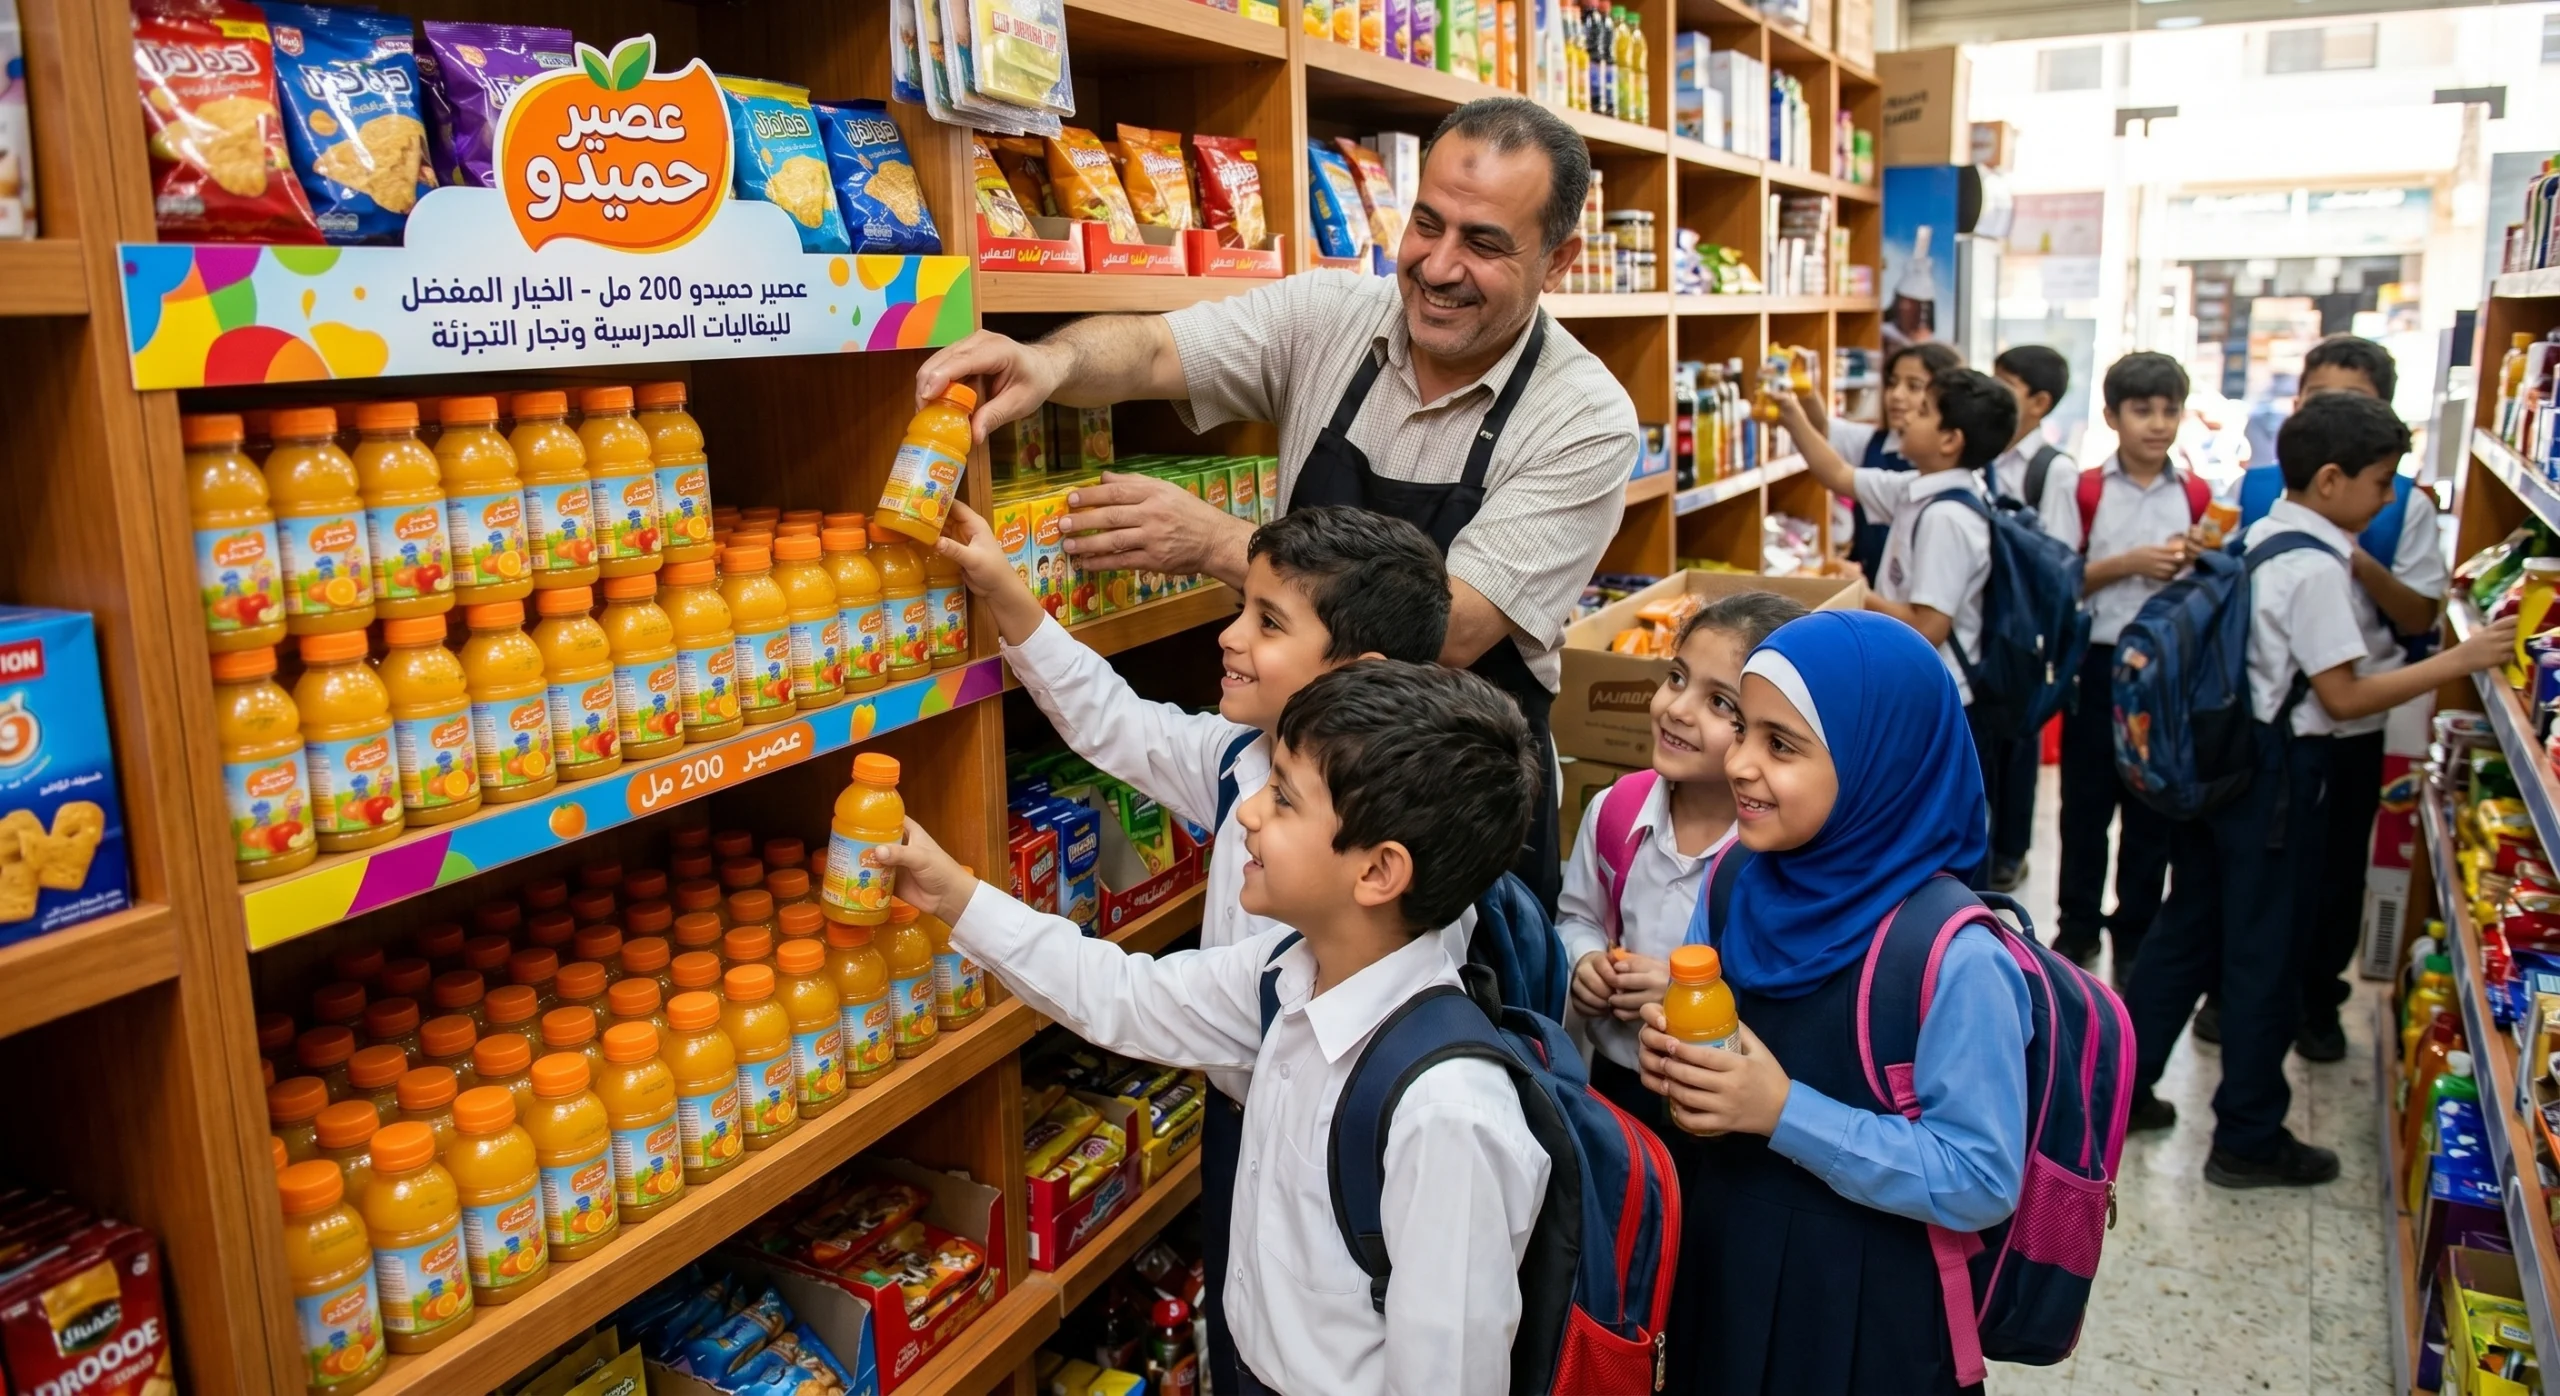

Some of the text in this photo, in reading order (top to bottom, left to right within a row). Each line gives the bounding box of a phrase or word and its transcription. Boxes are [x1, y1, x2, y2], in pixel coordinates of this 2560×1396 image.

[557, 103, 686, 153] عصير
[525, 152, 709, 222] حميدو
[401, 276, 503, 312] المفضل
[512, 277, 573, 310] الخيار
[599, 276, 631, 308] مل
[639, 276, 682, 301] 200
[690, 283, 753, 307] حميدو
[760, 281, 808, 305] عصير
[431, 320, 517, 356] التجزئة
[526, 318, 586, 353] وتجار
[594, 314, 696, 349] المدرسية
[641, 731, 801, 808] عصير 200 مل
